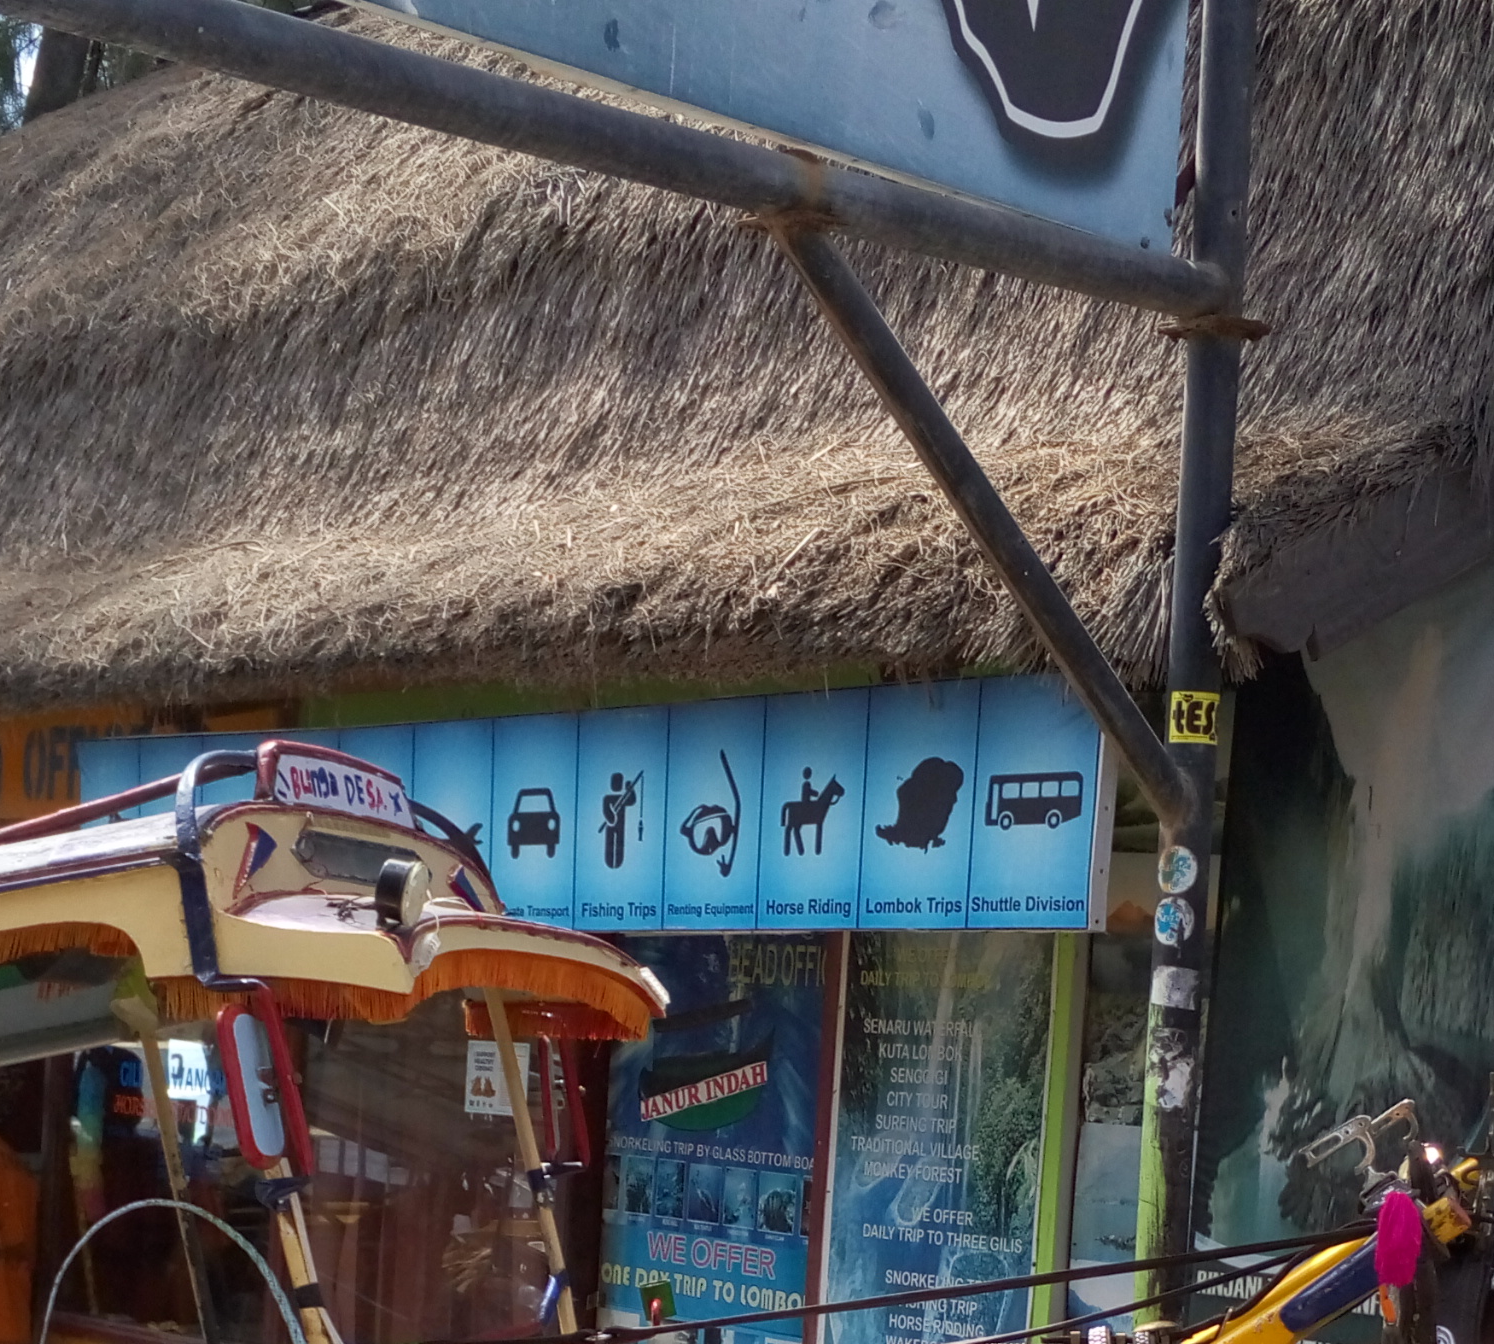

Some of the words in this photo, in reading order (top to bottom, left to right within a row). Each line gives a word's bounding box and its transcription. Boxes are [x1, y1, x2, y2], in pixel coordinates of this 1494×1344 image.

[527, 905, 570, 918] Transport
[581, 902, 625, 920] Fishing
[627, 902, 657, 920] Trips
[667, 903, 702, 918] Renting
[704, 902, 755, 918] Equipment
[766, 899, 805, 916] Horse
[807, 898, 852, 918] Riding
[865, 897, 923, 915] Lombok
[927, 897, 963, 917] Trips
[971, 895, 1021, 912] Shuttle
[1025, 895, 1085, 912] Division
[727, 943, 778, 985] HEAD
[860, 970, 892, 986] DAILY
[863, 1018, 911, 1037] SENARU
[878, 1043, 910, 1060] KUTA
[641, 1084, 701, 1120] JANUR
[705, 1063, 766, 1099] INDAH
[886, 1091, 914, 1107] CITY
[916, 1093, 948, 1110] TOUR
[875, 1114, 927, 1132] SURFING
[931, 1117, 957, 1134] TRIP
[673, 1142, 694, 1156] TRIP
[696, 1144, 711, 1158] BY
[712, 1145, 746, 1161] GLASS
[748, 1150, 791, 1168] BOTTOM
[851, 1135, 927, 1157] TRADITIONAL
[931, 1142, 981, 1161] VILLAGE
[864, 1161, 912, 1180] MONKEY
[915, 1164, 963, 1184] FOREST
[912, 1206, 931, 1222] WE
[933, 1208, 974, 1226] OFFER
[862, 1223, 896, 1241] DAILY
[898, 1226, 925, 1243] TRIP
[927, 1230, 944, 1246] TO
[947, 1232, 988, 1251] THREE
[990, 1236, 1024, 1254] GILIS
[648, 1230, 687, 1265] WE
[691, 1238, 776, 1280] OFFER
[601, 1262, 631, 1286] ONE
[673, 1273, 707, 1298] TRIP
[712, 1279, 735, 1303] TO
[740, 1284, 806, 1310] LOMBO
[950, 1299, 978, 1316] TRIP
[888, 1313, 932, 1332] HORSE
[932, 1320, 985, 1339] RIDDING
